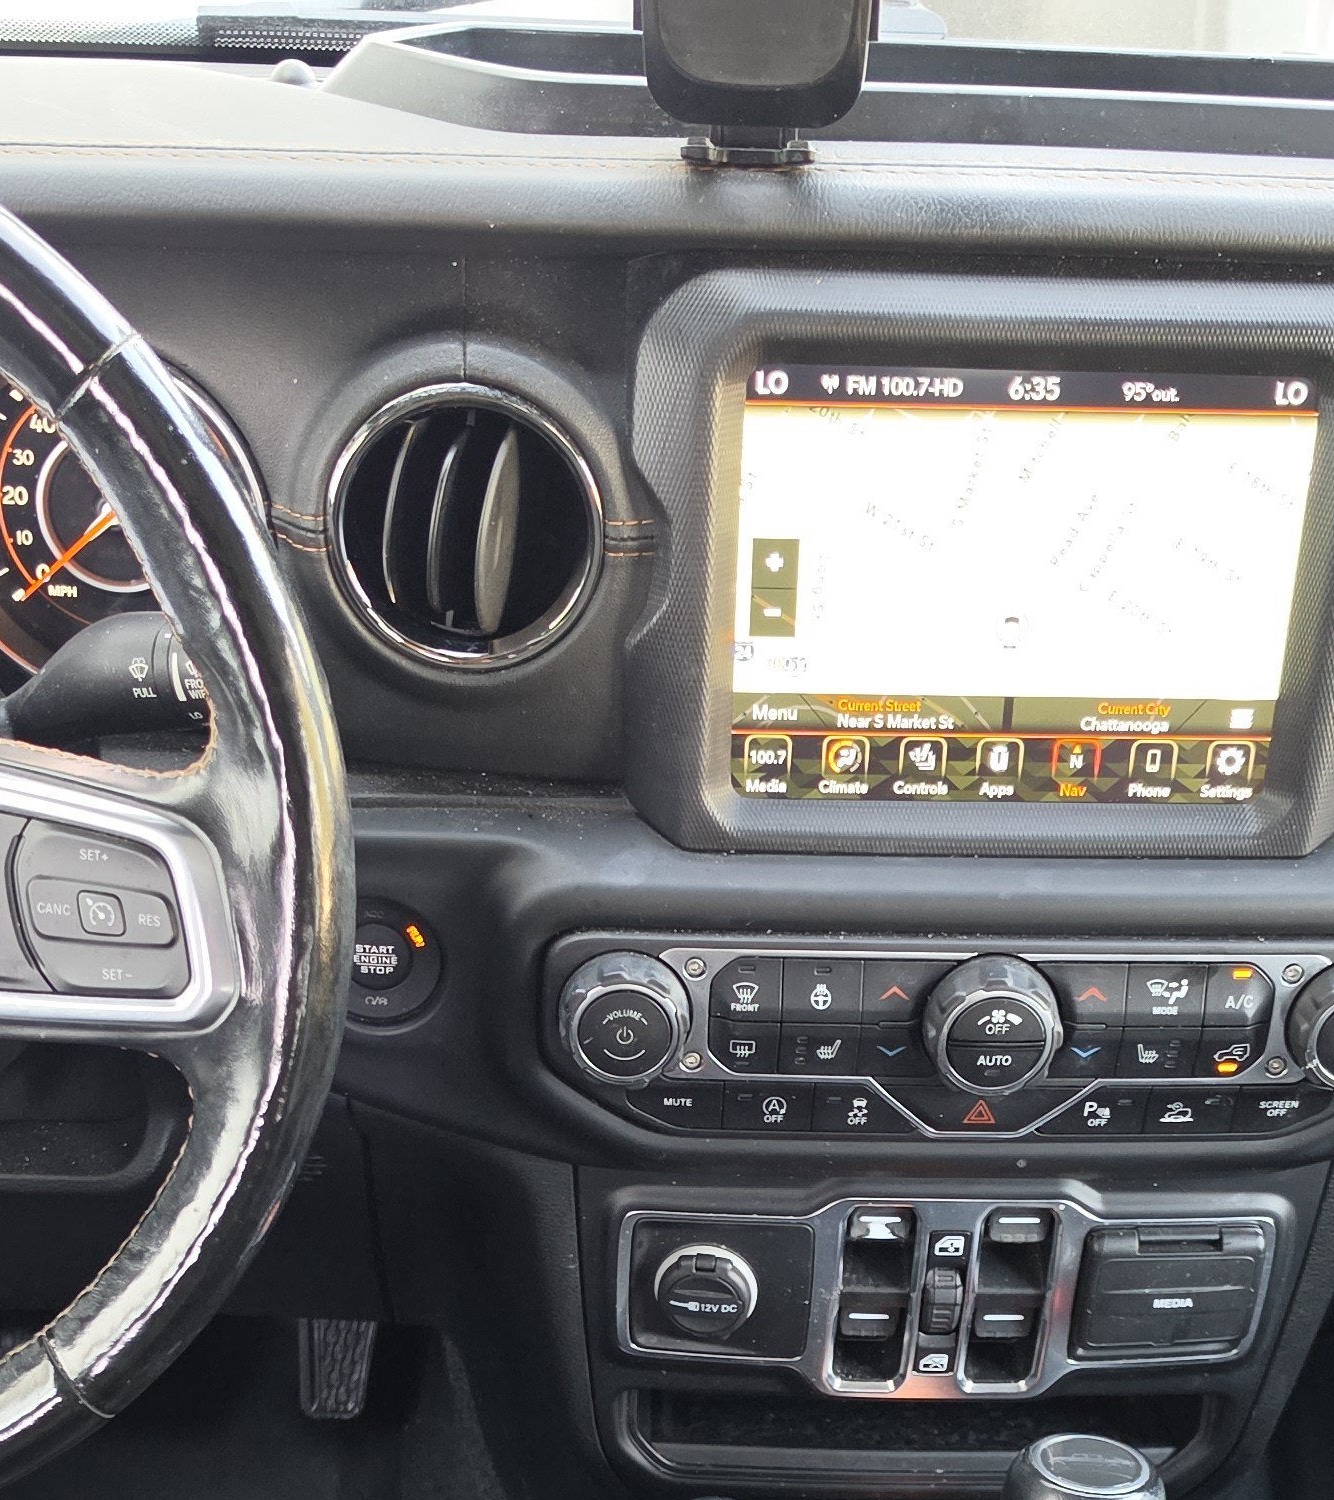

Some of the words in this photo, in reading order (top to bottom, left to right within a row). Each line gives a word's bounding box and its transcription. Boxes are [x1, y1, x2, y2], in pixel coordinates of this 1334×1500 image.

[754, 369, 789, 395] LO
[845, 374, 877, 396] FM
[881, 375, 964, 398] 100.7-HD
[1007, 375, 1061, 401] 6:35
[1274, 380, 1309, 406] LO
[29, 413, 57, 434] 40
[12, 449, 35, 466] 30
[2, 486, 29, 506] 20
[16, 530, 34, 546] 10
[47, 584, 78, 598] MPH
[132, 687, 158, 699] PULL
[752, 703, 799, 722] Menu
[837, 698, 883, 713] Current
[885, 699, 922, 713] Street
[1098, 702, 1144, 716] Current
[1145, 703, 1171, 718] City
[837, 713, 871, 730] Near
[874, 715, 885, 729] S
[887, 714, 933, 731] Market
[935, 716, 955, 731] St
[1080, 717, 1170, 735] Chattanooga
[750, 750, 787, 765] 100.7
[746, 779, 788, 794] Media
[818, 779, 869, 795] Climate
[893, 779, 949, 797] Controls
[979, 782, 1014, 798] Apps
[1059, 783, 1087, 798] Nav
[1127, 782, 1172, 798] Phone
[1200, 783, 1254, 800] Settings
[36, 901, 71, 917] CANC
[138, 913, 162, 928] RES
[355, 944, 395, 954] START
[353, 954, 398, 965] ENGINE
[360, 966, 394, 975] STOP
[731, 1003, 760, 1013] FRONT
[1225, 995, 1254, 1010] A/C
[606, 1009, 643, 1021] VOLUME
[1152, 1006, 1179, 1016] MODE
[985, 1023, 1010, 1036] OFF
[977, 1054, 1012, 1067] AUTO
[663, 1097, 693, 1107] MUTE
[1259, 1100, 1299, 1110] SCREEN
[764, 1114, 784, 1124] OFF
[847, 1115, 867, 1126] OFF
[1267, 1109, 1287, 1118] OFF
[1087, 1118, 1108, 1127] OFF
[700, 1303, 721, 1314] 12V
[721, 1304, 737, 1314] DC
[1152, 1297, 1194, 1309] MEDIA
